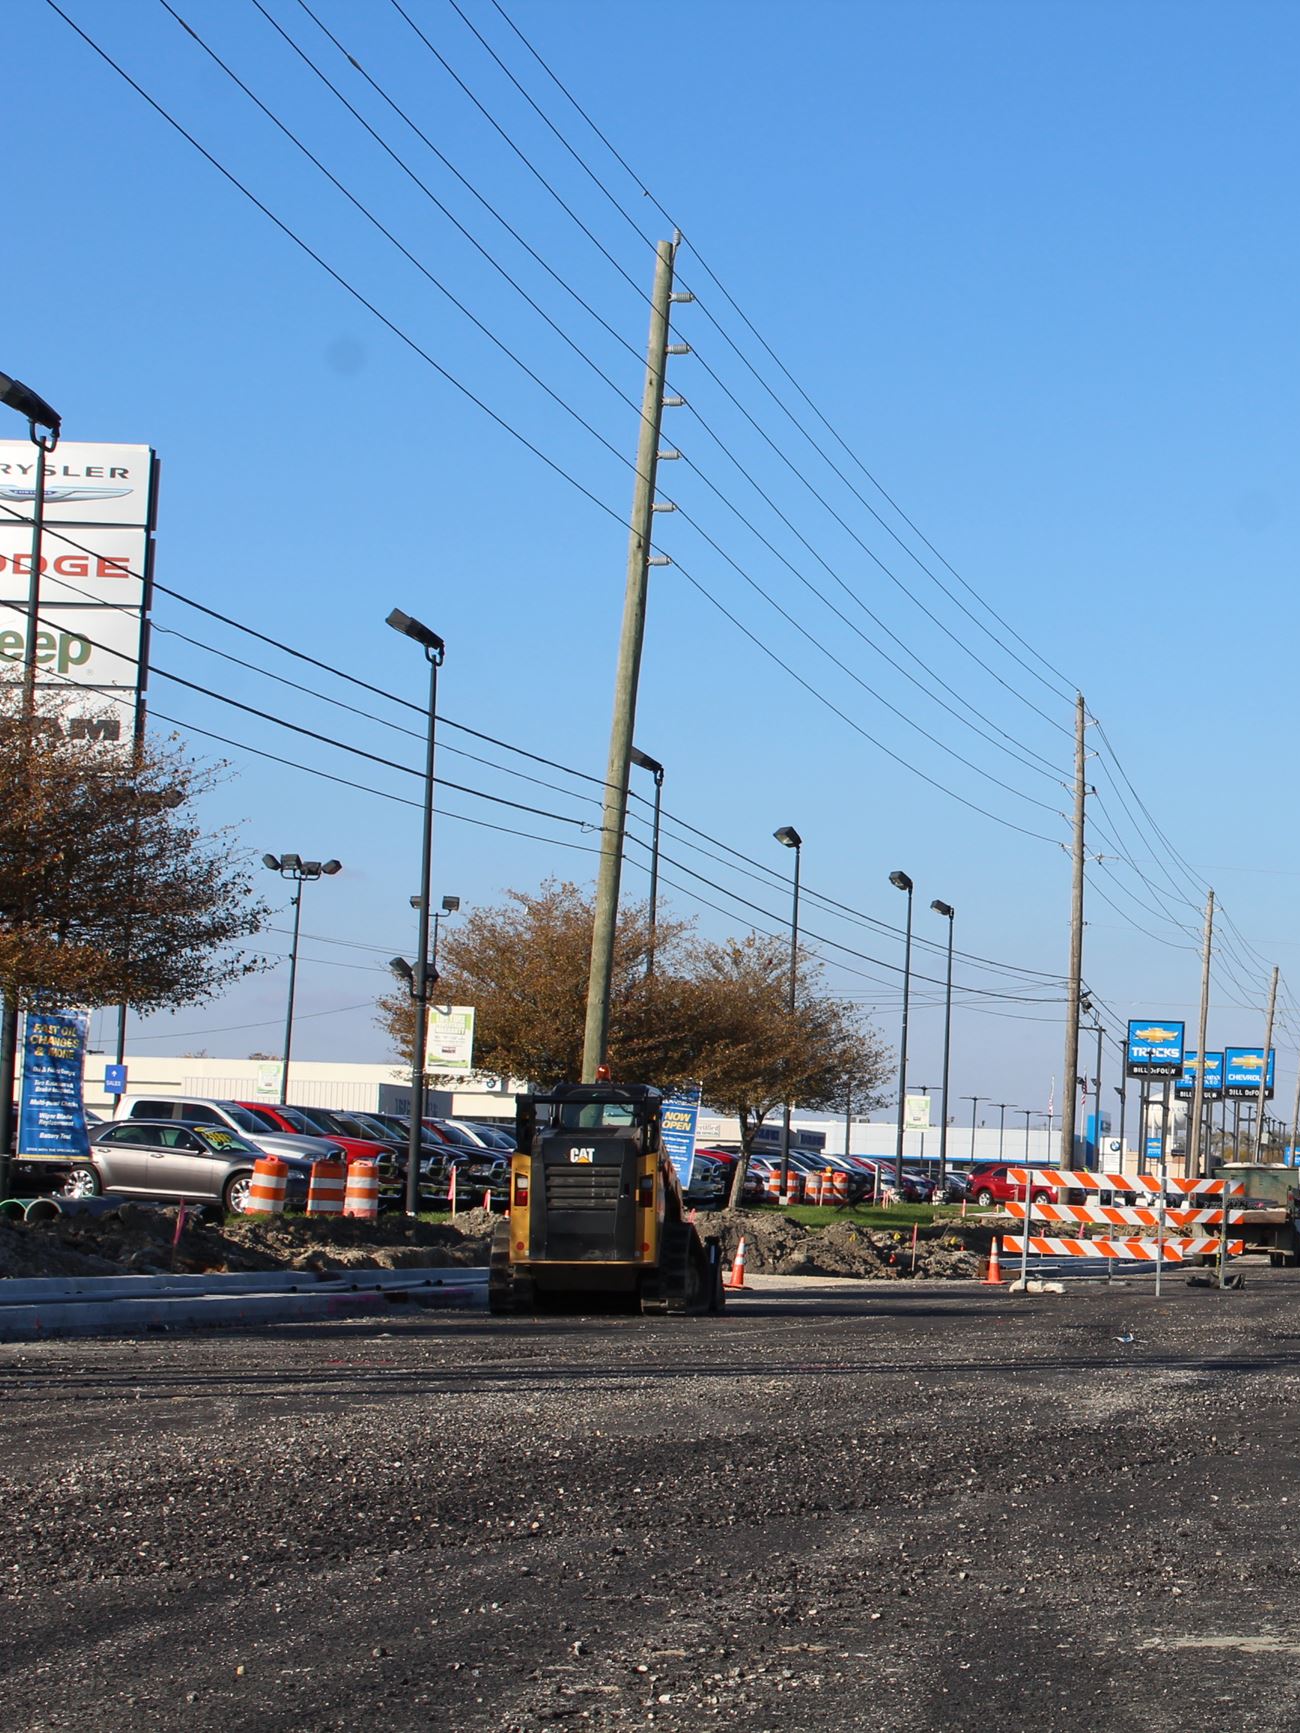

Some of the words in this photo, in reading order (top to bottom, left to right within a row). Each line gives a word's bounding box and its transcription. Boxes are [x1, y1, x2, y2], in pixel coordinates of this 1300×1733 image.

[33, 1023, 60, 1034] FAST
[61, 1027, 77, 1037] OIL
[29, 1034, 80, 1049] CHANGES
[34, 1046, 45, 1057] &
[47, 1047, 75, 1059] MORE
[1227, 1073, 1270, 1082] CHEVROLT
[664, 1111, 692, 1122] NOW
[661, 1120, 692, 1131] OPEN
[570, 1147, 595, 1163] CAT
